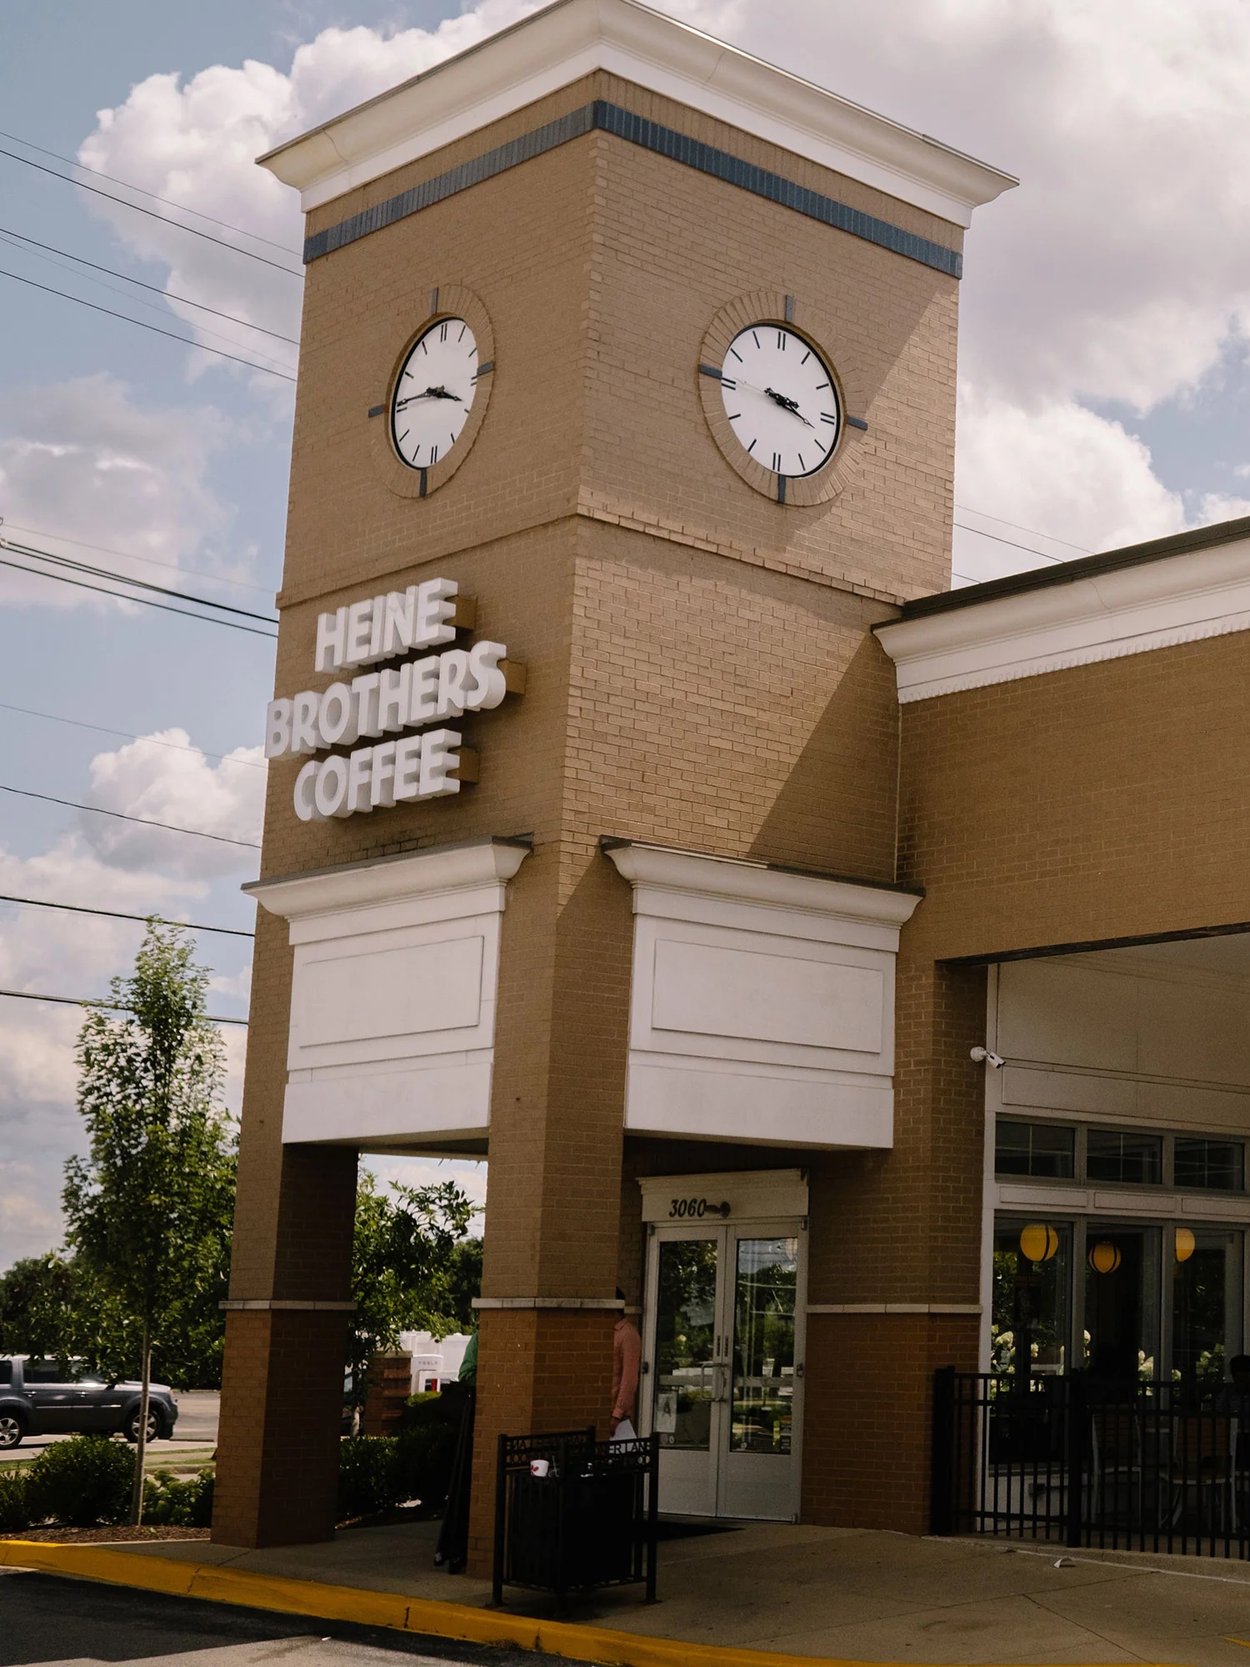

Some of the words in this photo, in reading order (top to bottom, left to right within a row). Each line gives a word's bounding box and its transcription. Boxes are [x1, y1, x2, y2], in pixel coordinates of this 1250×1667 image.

[315, 577, 458, 674] HEINE
[264, 640, 507, 761] BROTHERS
[294, 728, 462, 822] COFFEE
[669, 1198, 707, 1218] 3060
